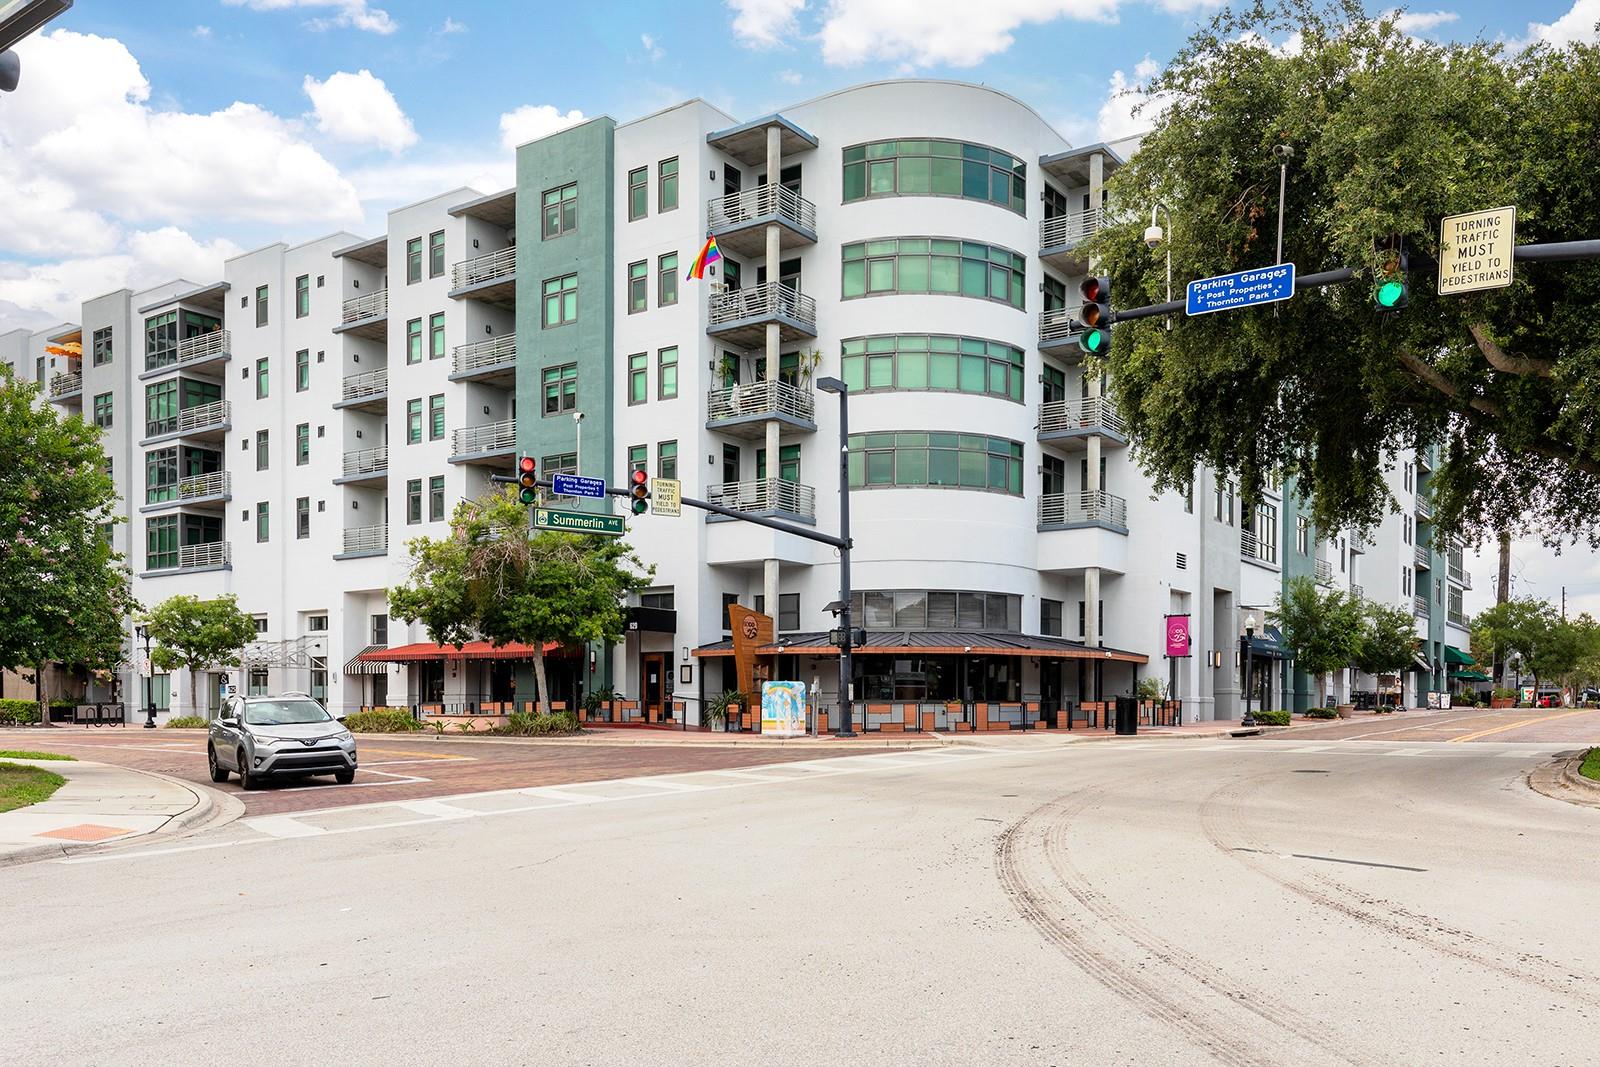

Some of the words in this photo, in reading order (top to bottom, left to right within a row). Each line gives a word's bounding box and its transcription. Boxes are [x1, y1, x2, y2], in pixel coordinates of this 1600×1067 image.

[1456, 216, 1501, 232] TURNING
[1456, 229, 1499, 244] TRAFFIC
[1458, 243, 1494, 259] MUST
[1452, 260, 1481, 273] YIELD
[1488, 257, 1501, 268] TO
[1193, 278, 1234, 292] Parking
[1241, 268, 1287, 283] Garages
[1442, 269, 1509, 287] PEDESTRIANS
[1206, 290, 1225, 299] Post
[1229, 282, 1273, 295] Properties
[1207, 297, 1244, 308] Thornton
[1249, 292, 1270, 300] Park
[556, 475, 578, 484] Parking
[580, 478, 602, 486] Garages
[658, 493, 673, 501] MUST
[552, 514, 604, 529] Summerlin
